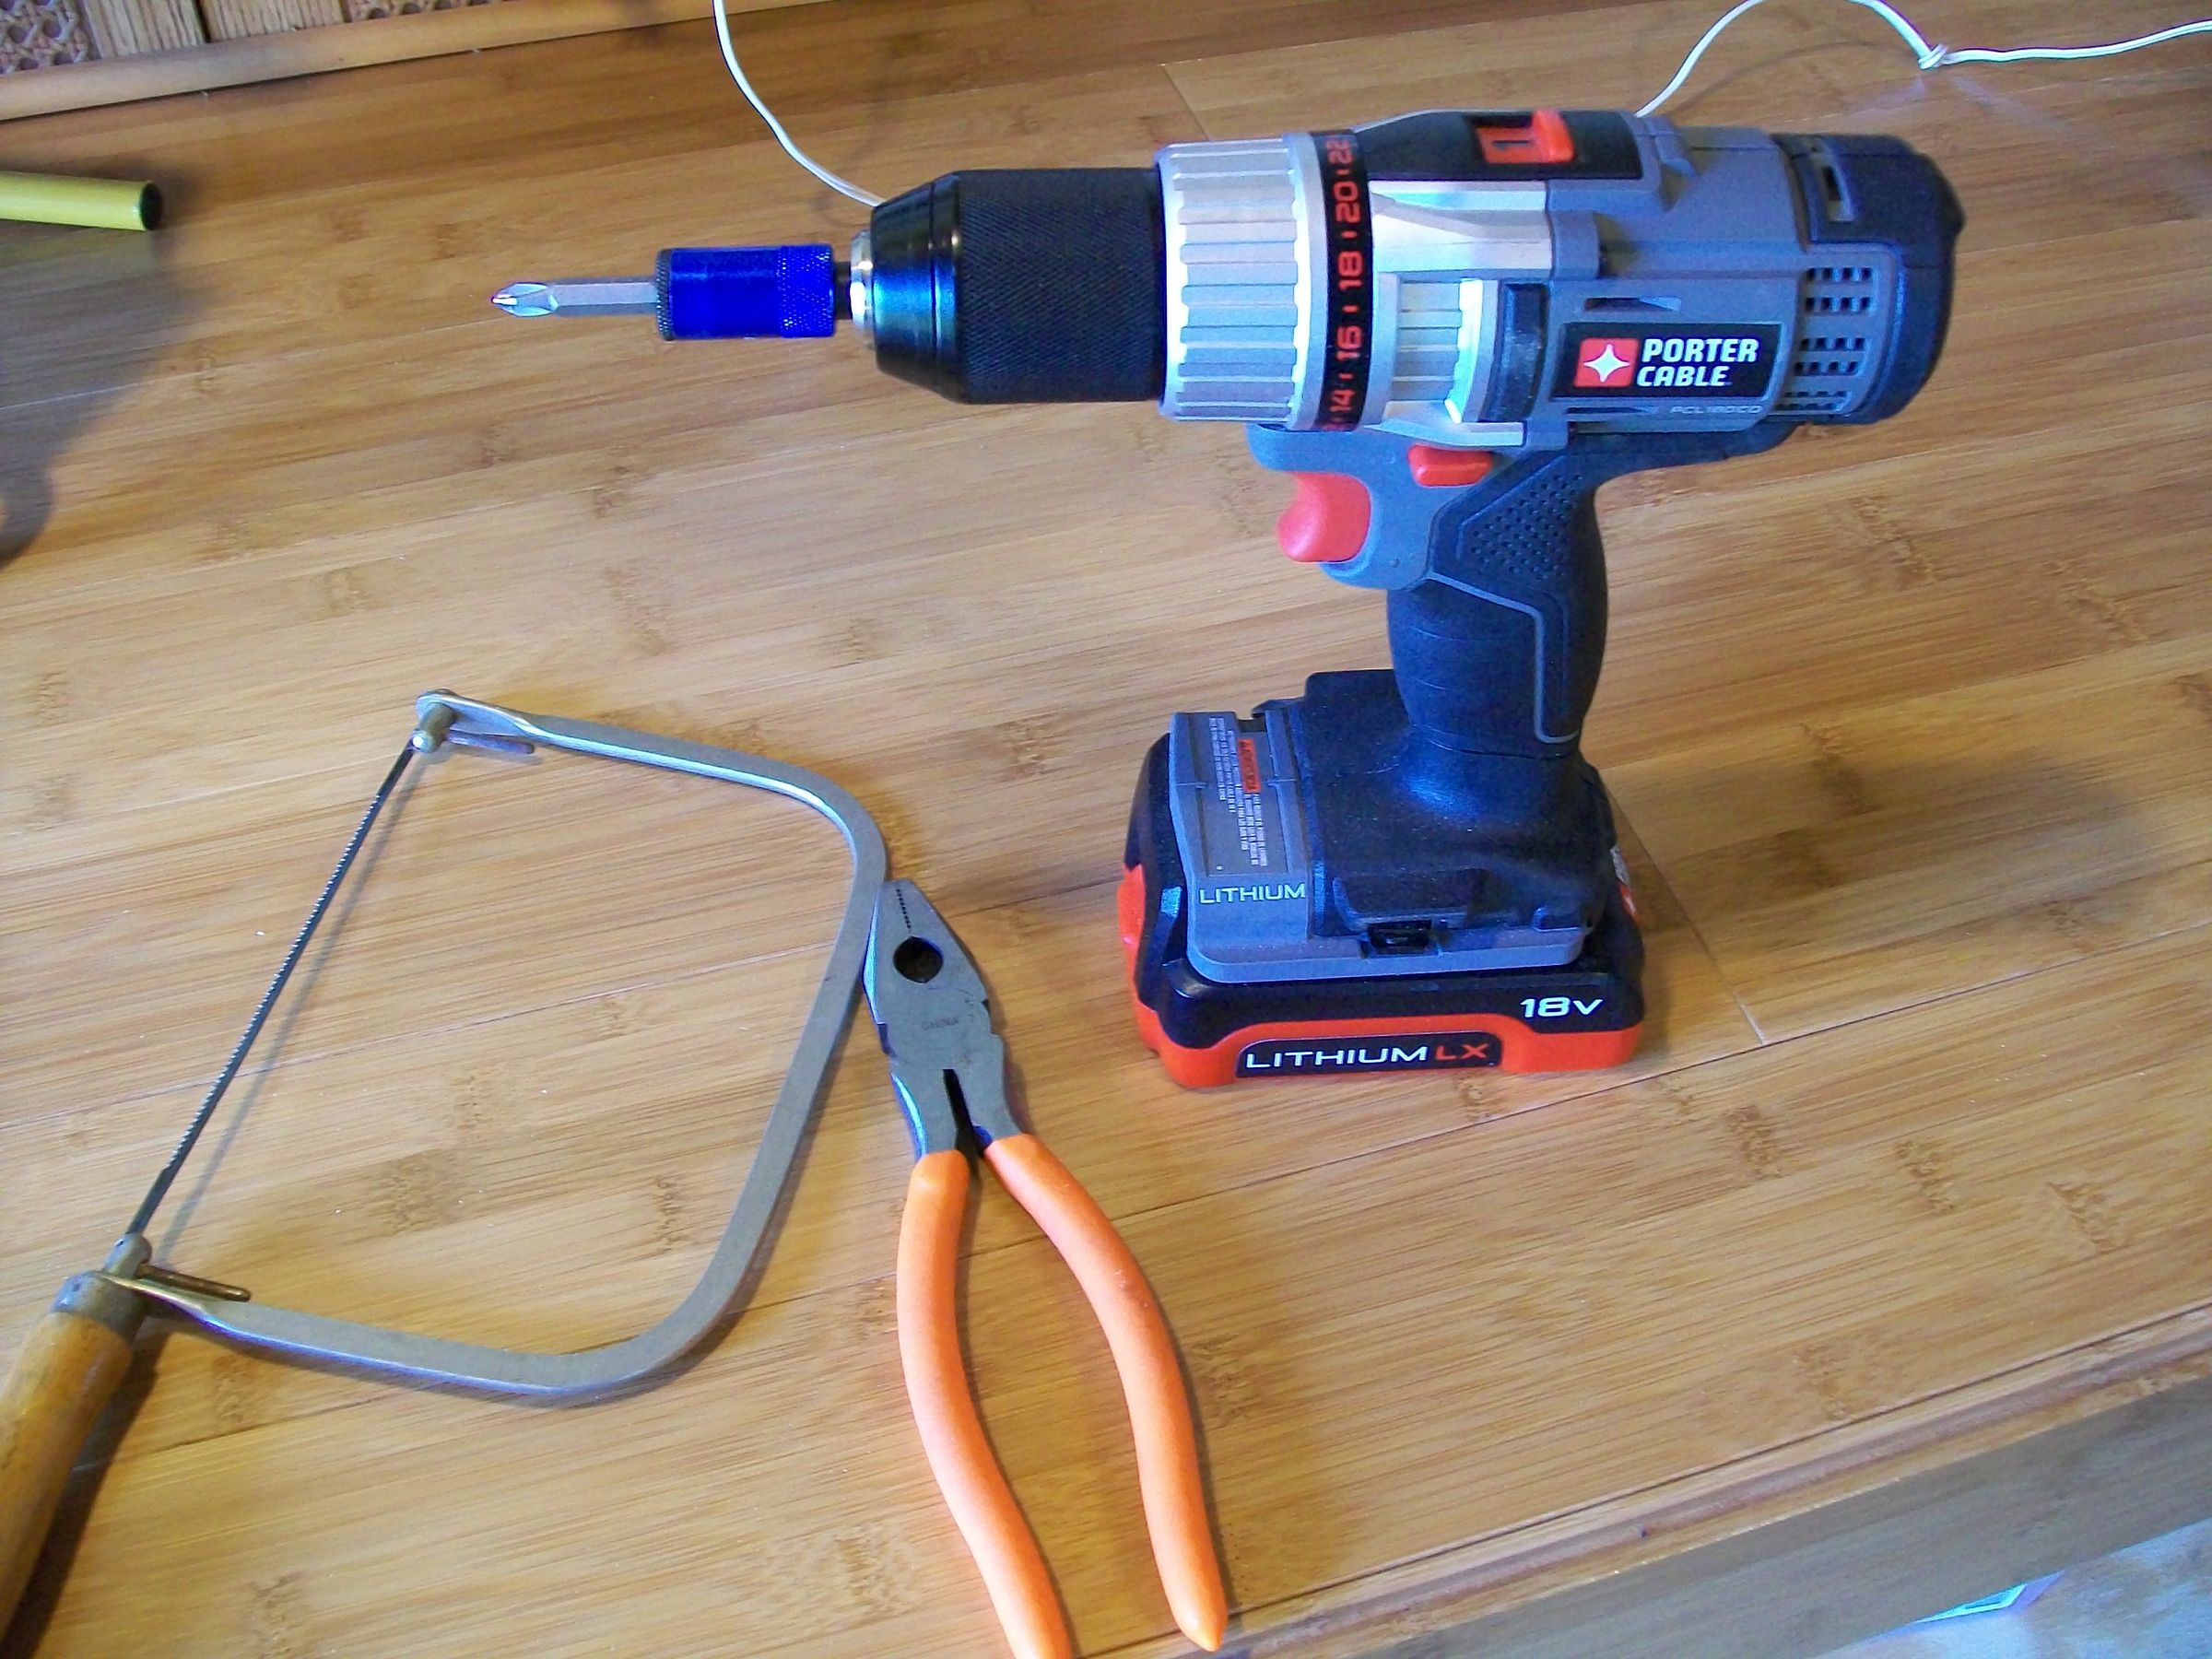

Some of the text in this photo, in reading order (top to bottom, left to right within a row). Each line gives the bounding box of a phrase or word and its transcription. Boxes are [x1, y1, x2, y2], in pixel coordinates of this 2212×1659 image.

[1333, 181, 1361, 223] 20
[1338, 250, 1363, 290] 18
[1336, 325, 1362, 360] 16
[1641, 338, 1759, 362] PORTER
[1637, 366, 1731, 387] CABLE
[1330, 389, 1355, 411] 14
[1199, 883, 1307, 905] LITHIUM
[1246, 1042, 1489, 1069] LITHIUM LX
